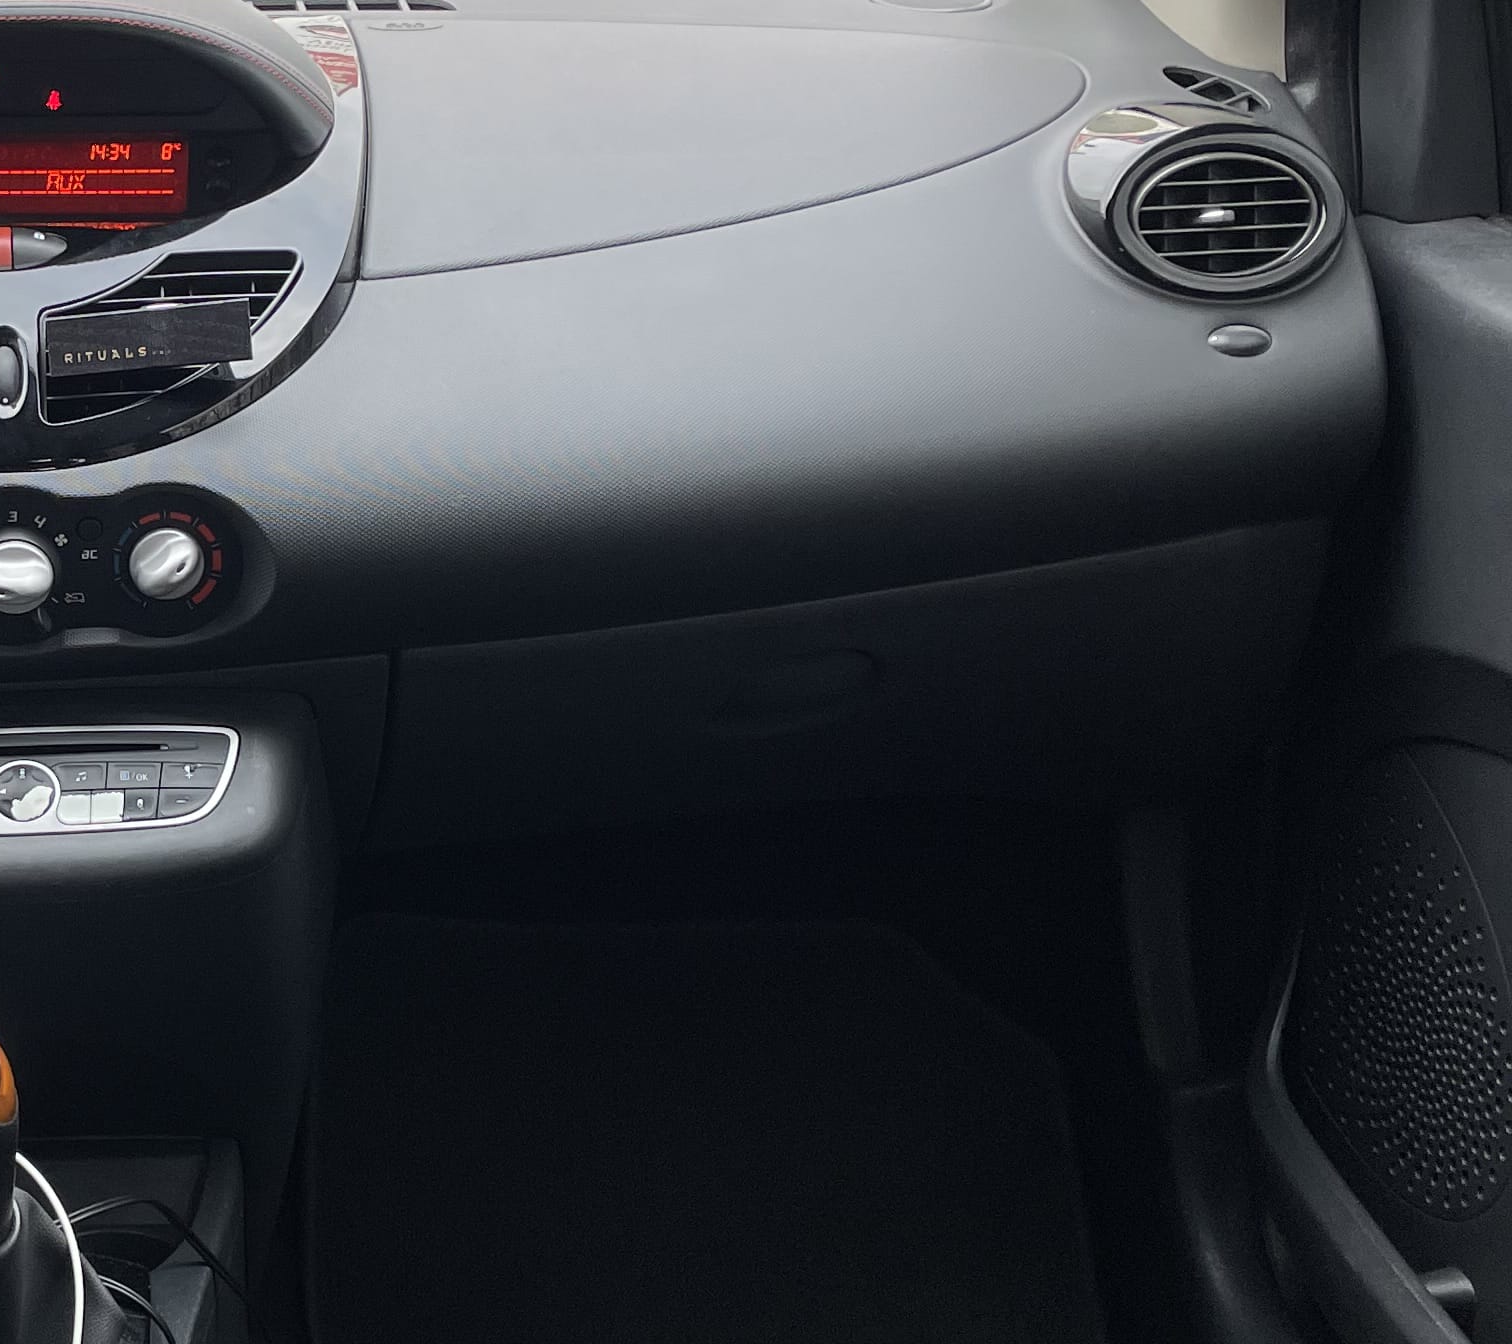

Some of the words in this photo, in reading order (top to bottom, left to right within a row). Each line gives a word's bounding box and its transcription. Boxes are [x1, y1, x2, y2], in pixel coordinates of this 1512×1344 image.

[90, 142, 131, 161] 14:34
[46, 171, 86, 191] AUX
[7, 511, 18, 523] 3
[33, 515, 47, 529] 4
